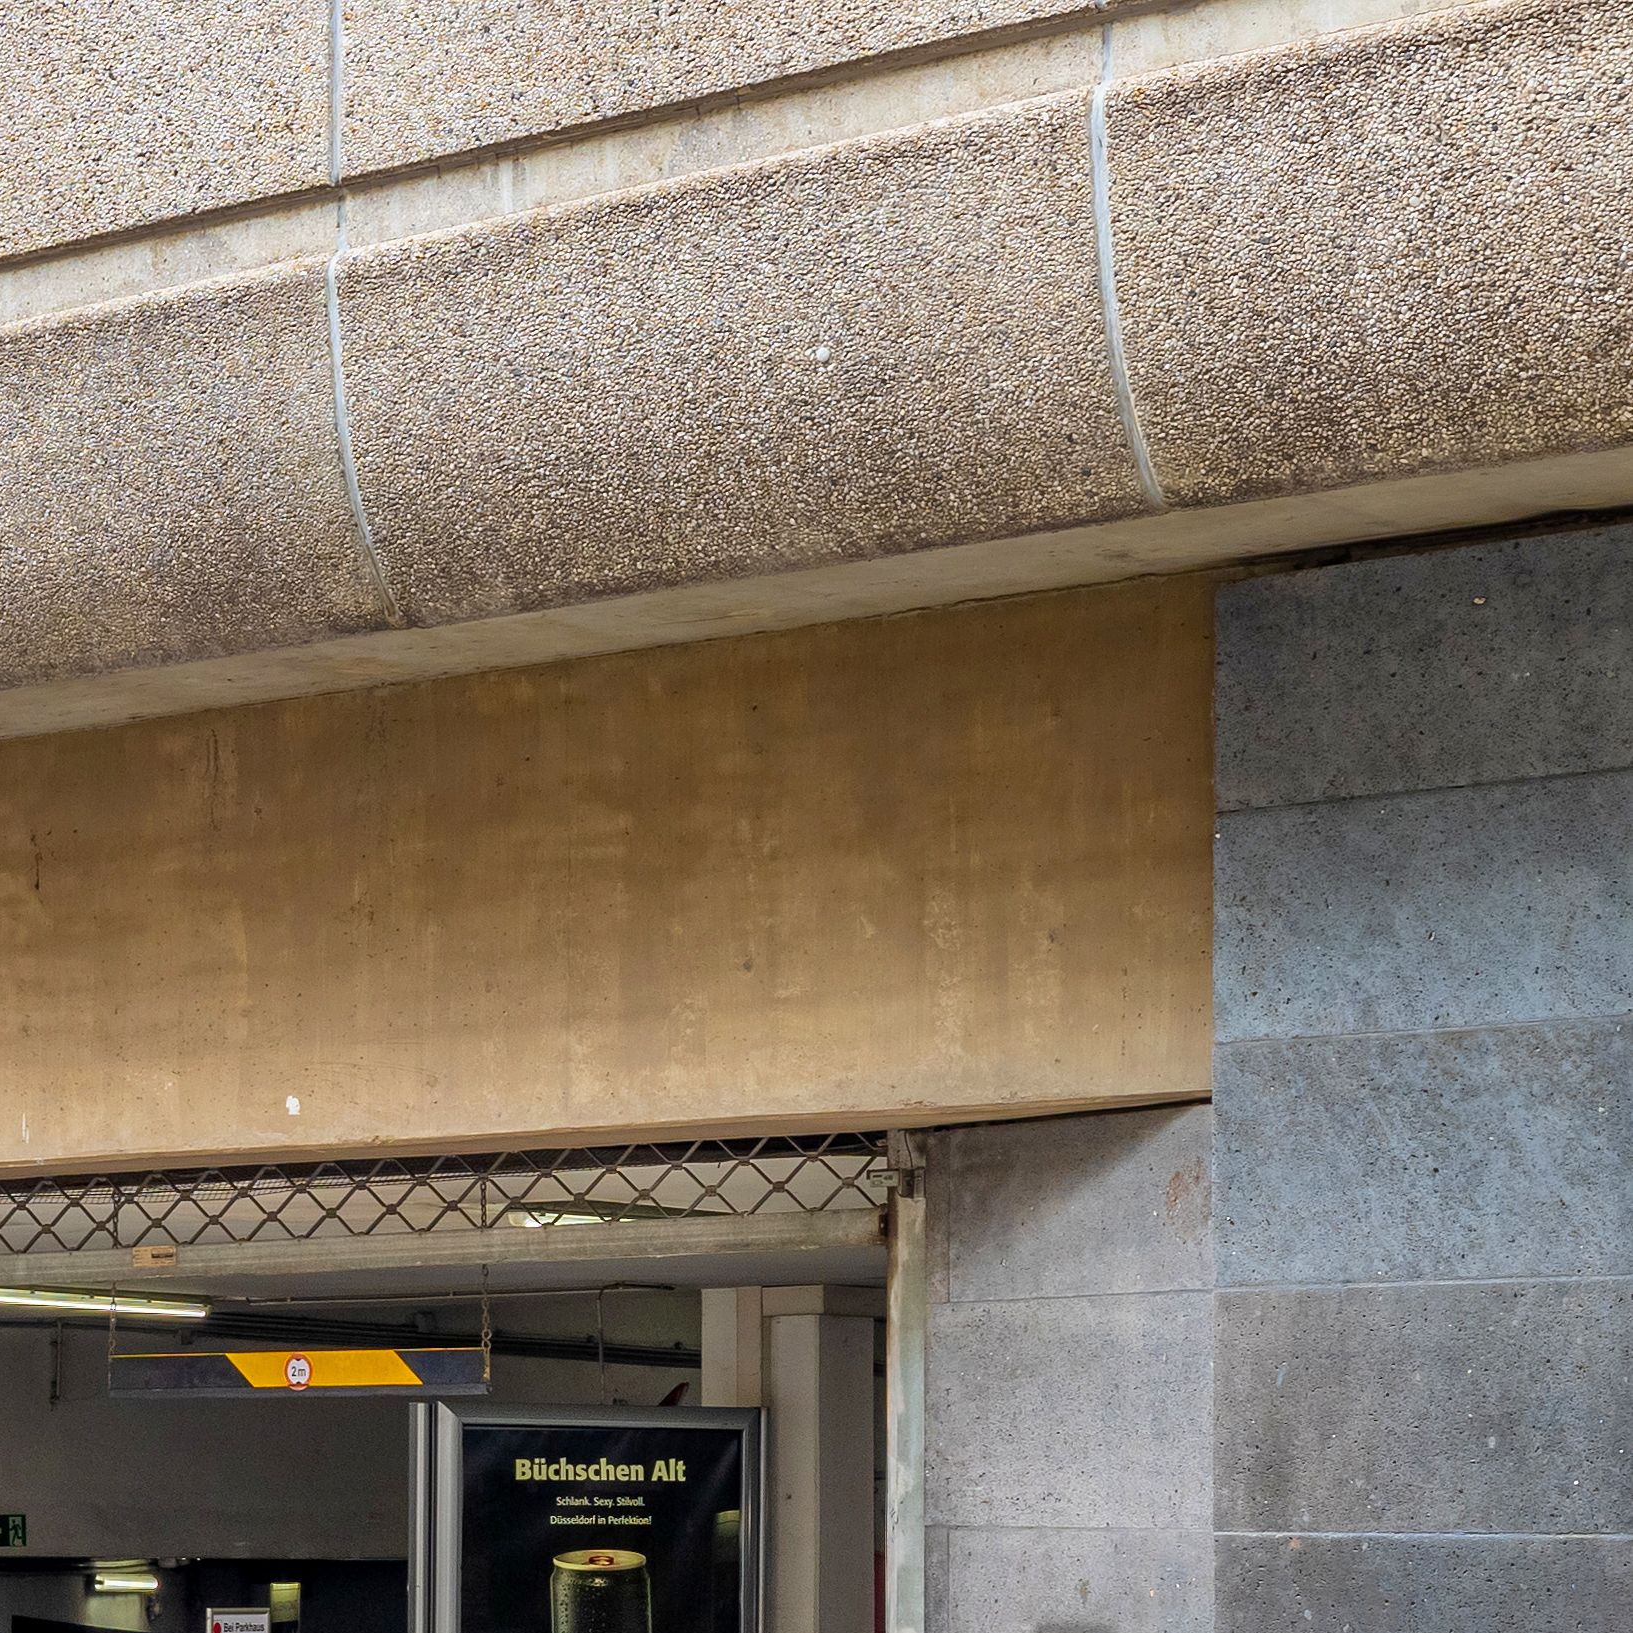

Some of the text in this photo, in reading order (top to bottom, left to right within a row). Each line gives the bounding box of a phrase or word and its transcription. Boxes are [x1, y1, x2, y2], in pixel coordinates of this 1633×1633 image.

[515, 1457, 686, 1482] Büchschen Alt
[556, 1496, 645, 1509] Schlank. Sexy. Stilvoll.
[550, 1515, 652, 1525] Düsseldorf in Perfektion!
[223, 1622, 265, 1632] Bei Parkhaus
